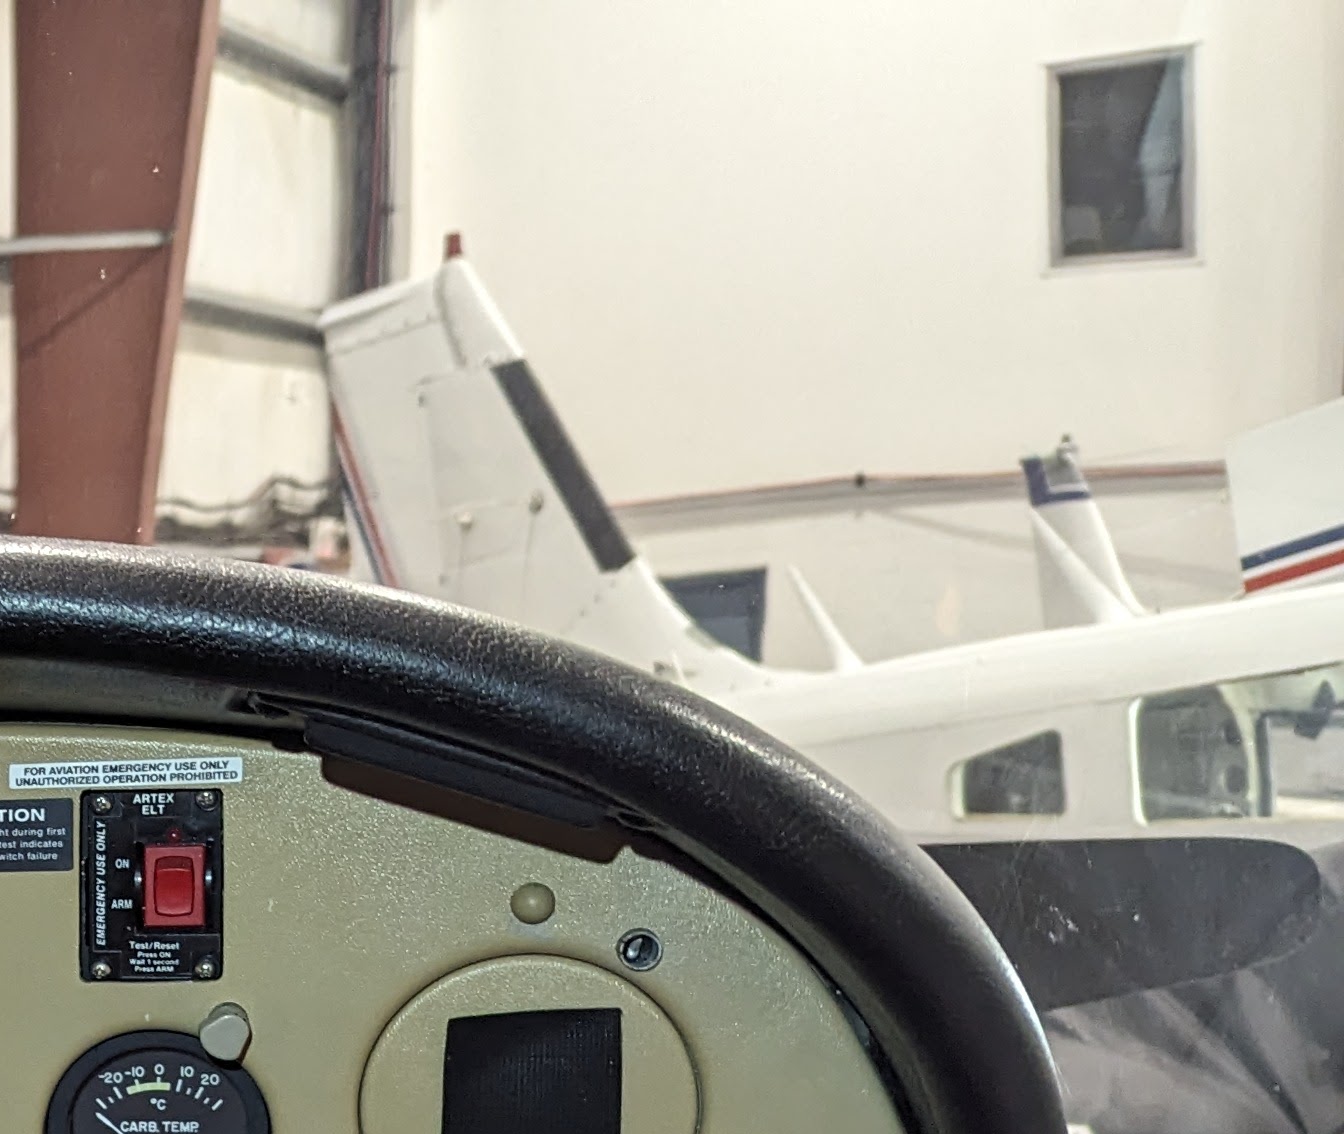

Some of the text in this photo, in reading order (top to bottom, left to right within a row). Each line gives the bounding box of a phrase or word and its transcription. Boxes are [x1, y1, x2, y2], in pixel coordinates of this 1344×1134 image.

[24, 760, 230, 776] FOR AVIATION EMERGENCY USE ONLY
[15, 770, 238, 786] UNAUTHORIZED OPERATION PROHIBITED
[132, 793, 174, 804] ARTEX
[142, 805, 164, 815] ELT
[12, 828, 44, 838] during
[46, 827, 66, 836] first
[19, 839, 63, 848] indicates
[27, 851, 58, 861] failure
[115, 858, 129, 869] ON
[96, 821, 106, 945] EMERGENCY USE ONLY
[111, 899, 132, 909] ARM
[129, 941, 179, 949] Test/Reset
[180, 1066, 194, 1077] 10
[200, 1074, 219, 1085] 20
[120, 1122, 160, 1132] CARB.
